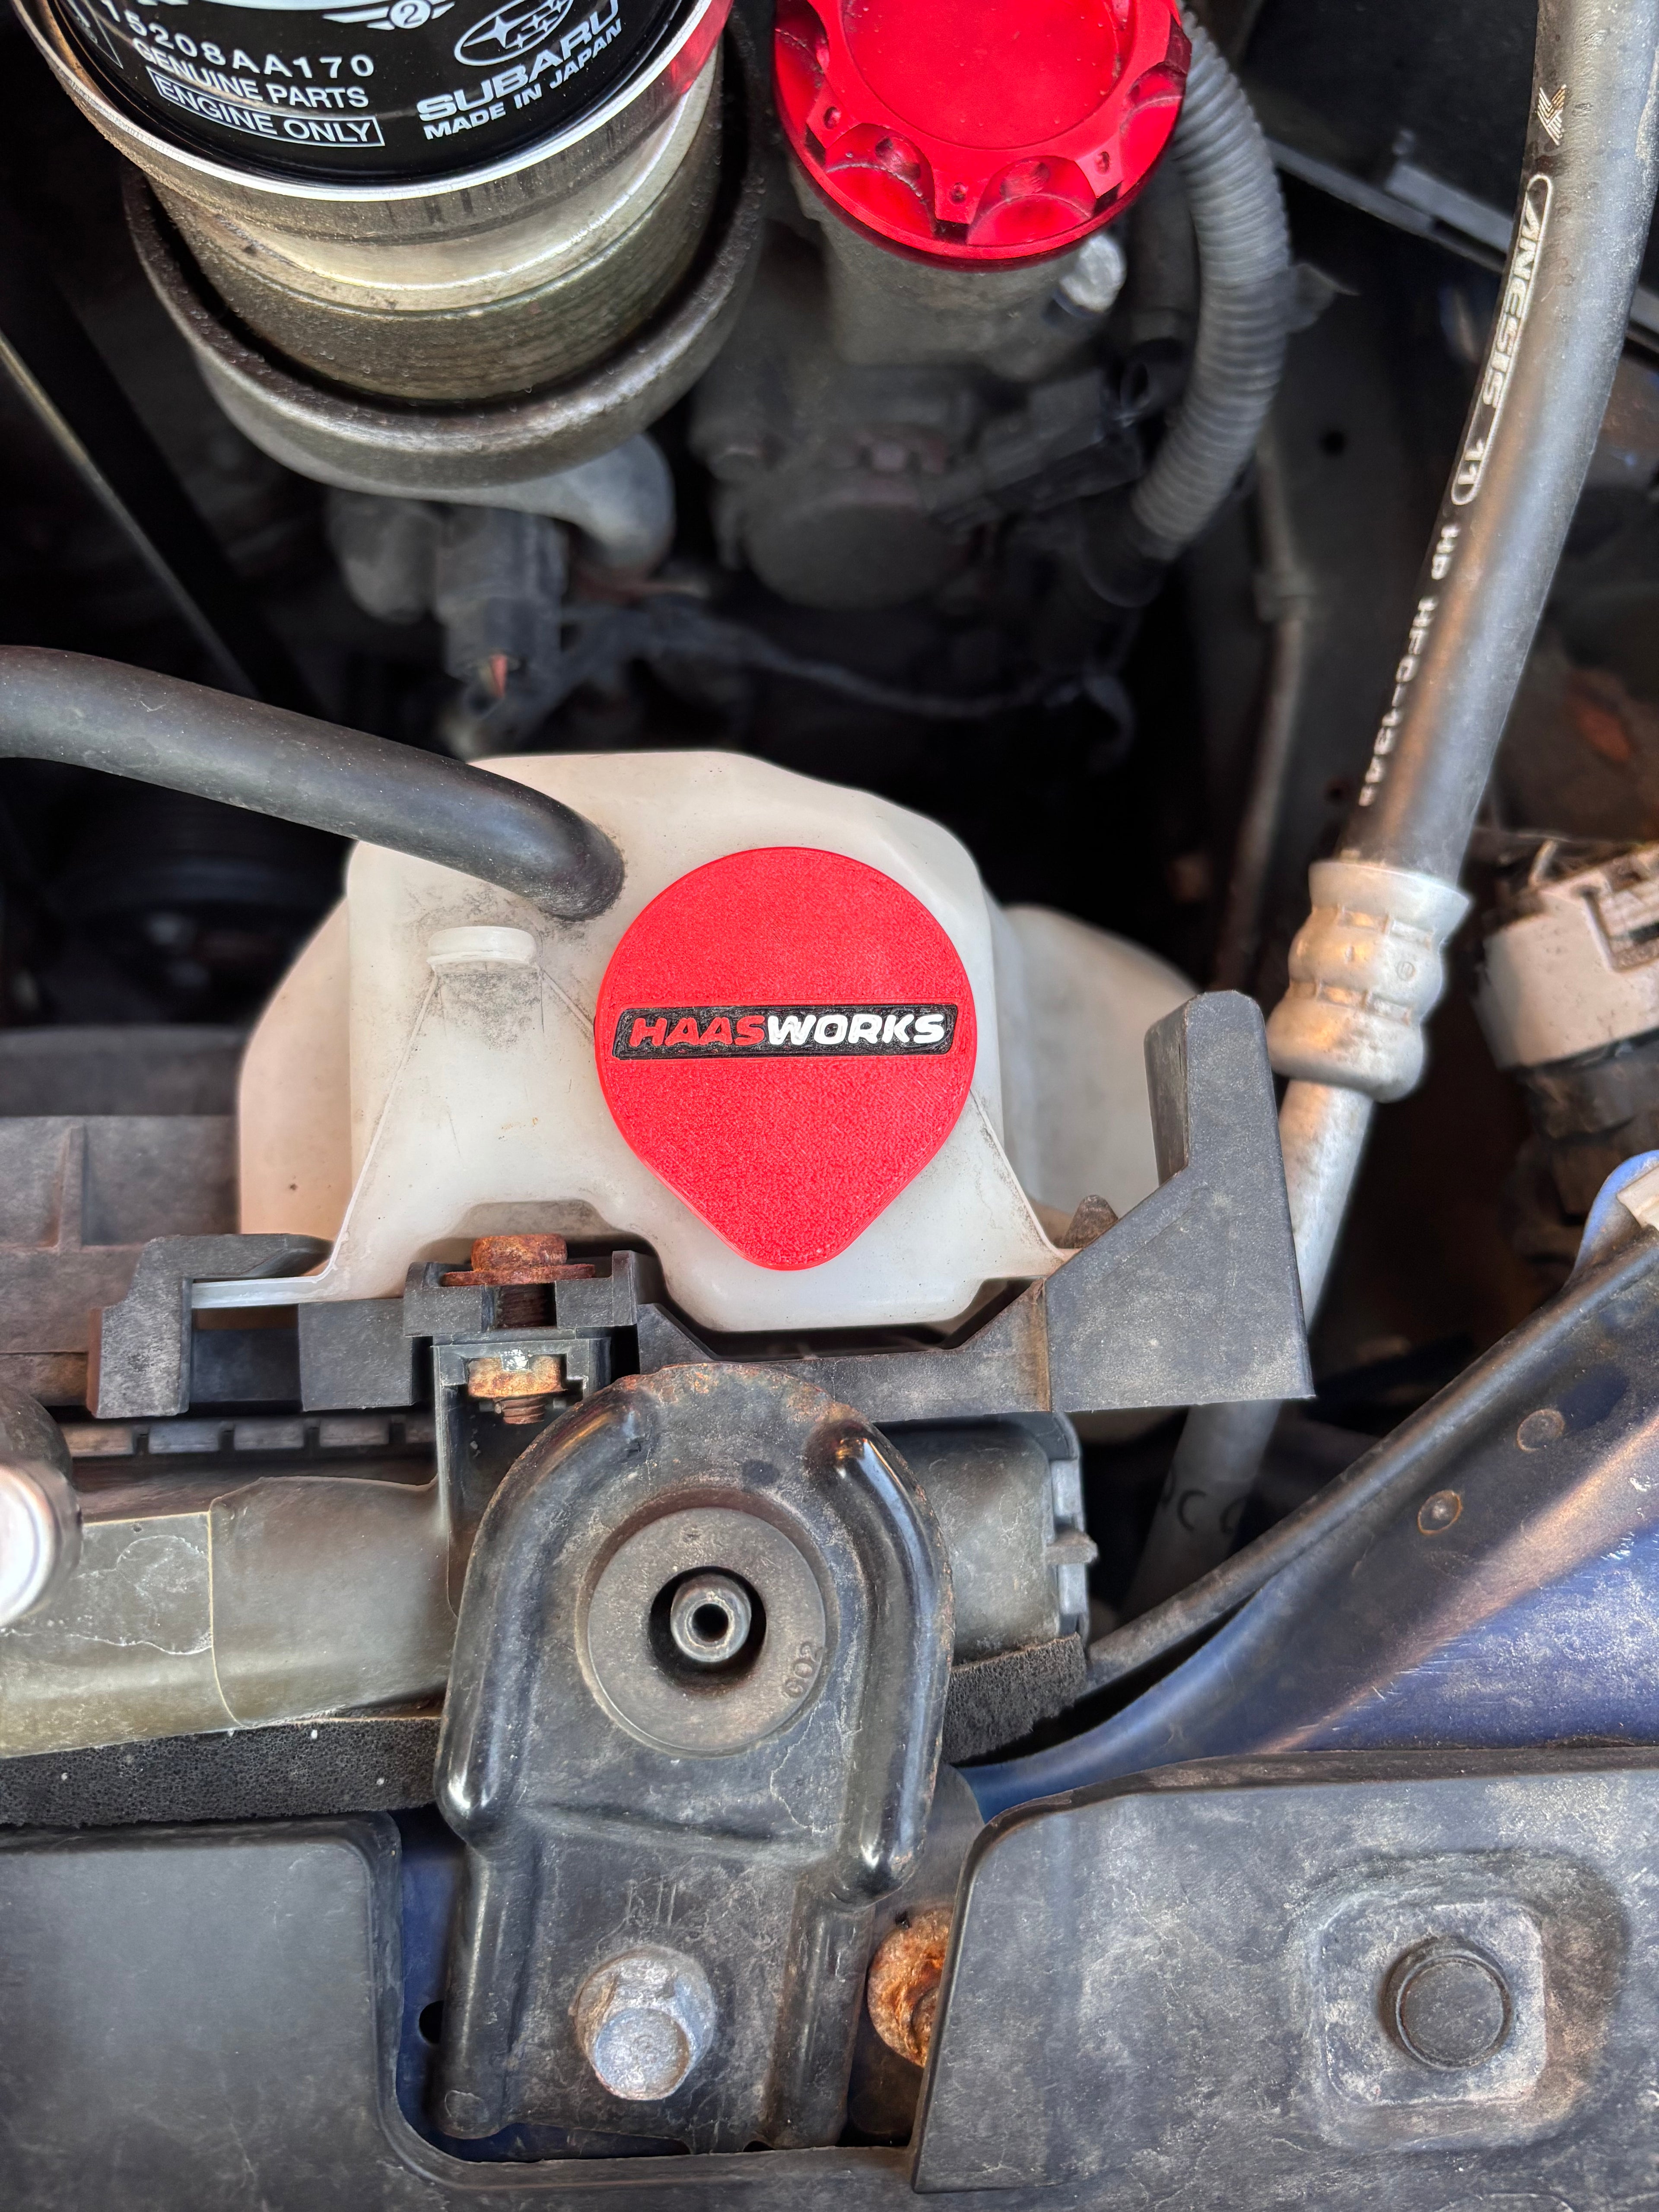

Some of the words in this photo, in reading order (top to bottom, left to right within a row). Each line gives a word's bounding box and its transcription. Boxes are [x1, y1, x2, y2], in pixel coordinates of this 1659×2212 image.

[99, 0, 374, 78] 15208AA170
[400, 3, 422, 26] 2
[133, 38, 264, 102] GENUINE
[270, 83, 369, 109] PARTS
[416, 0, 619, 121] SUBARU
[423, 101, 506, 141] MADE
[514, 84, 542, 109] IN
[549, 18, 622, 89] JAPAN
[157, 76, 278, 136] ENGINE
[283, 118, 372, 143] ONLY
[628, 1013, 945, 1048] HAASWORKS
